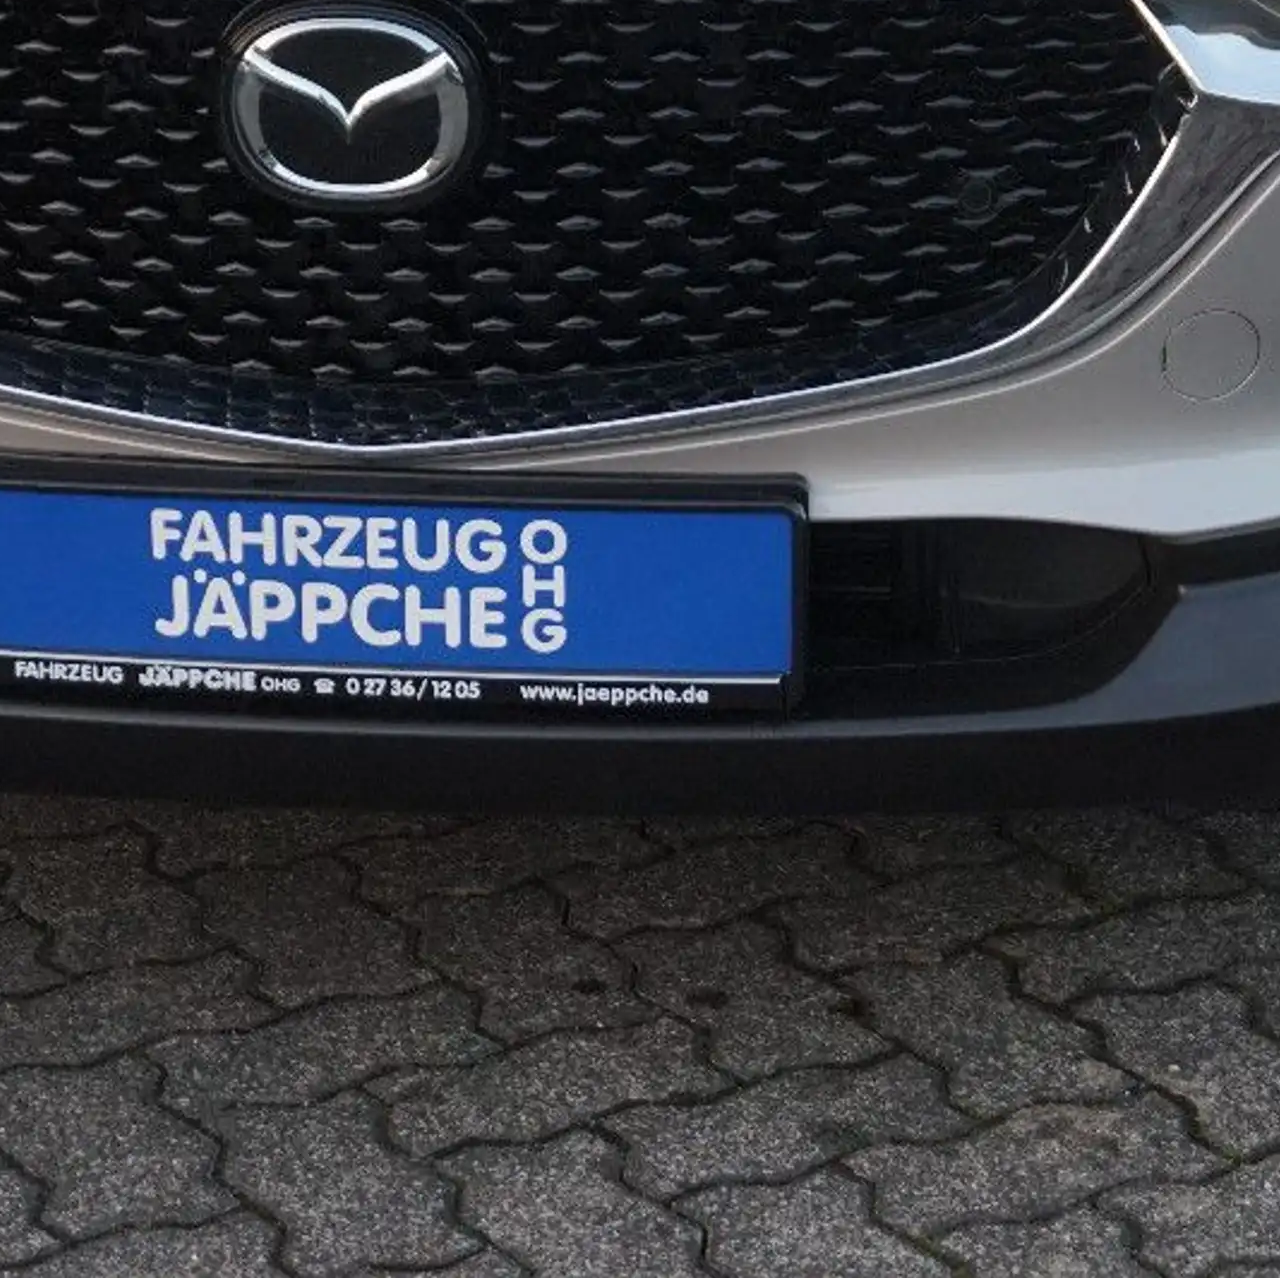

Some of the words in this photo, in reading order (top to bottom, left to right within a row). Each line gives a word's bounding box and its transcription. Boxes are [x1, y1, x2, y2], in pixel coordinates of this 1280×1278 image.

[149, 507, 508, 573] FAHRZEUG
[154, 569, 508, 649] JÄPPCHE
[14, 661, 124, 684] FAHRZEUG
[138, 664, 258, 691] JÄPPCHE
[260, 677, 301, 693] OHG
[520, 682, 710, 706] www.jaeppche.de
